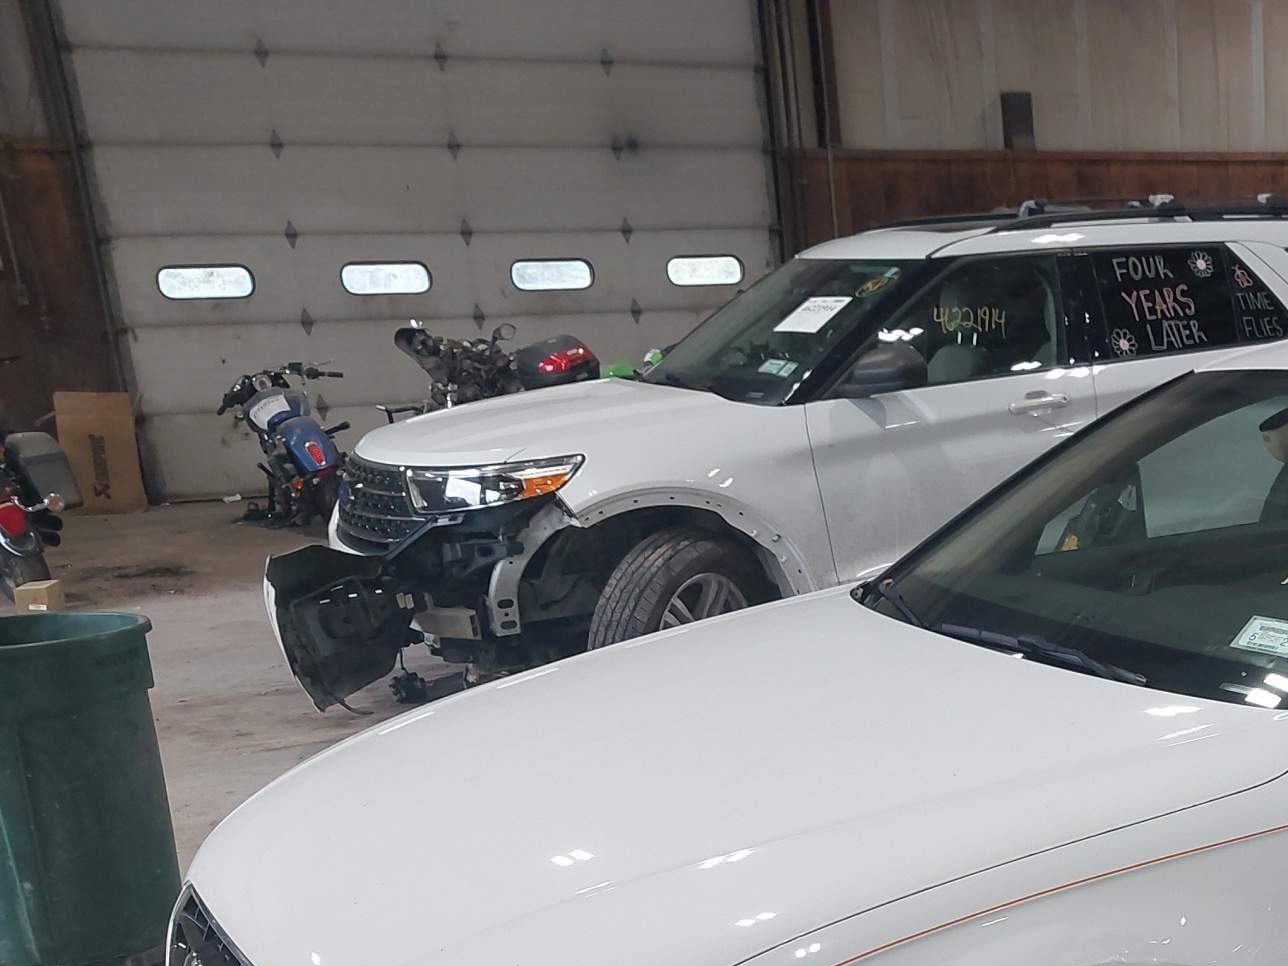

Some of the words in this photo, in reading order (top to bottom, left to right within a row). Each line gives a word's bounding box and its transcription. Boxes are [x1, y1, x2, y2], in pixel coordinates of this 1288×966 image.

[1111, 255, 1175, 282] FOUR
[1120, 284, 1196, 322] YEARS
[1235, 291, 1275, 311] TIME
[933, 306, 1006, 339] 46221914
[1146, 319, 1209, 350] LATER
[1242, 316, 1284, 338] FLIES
